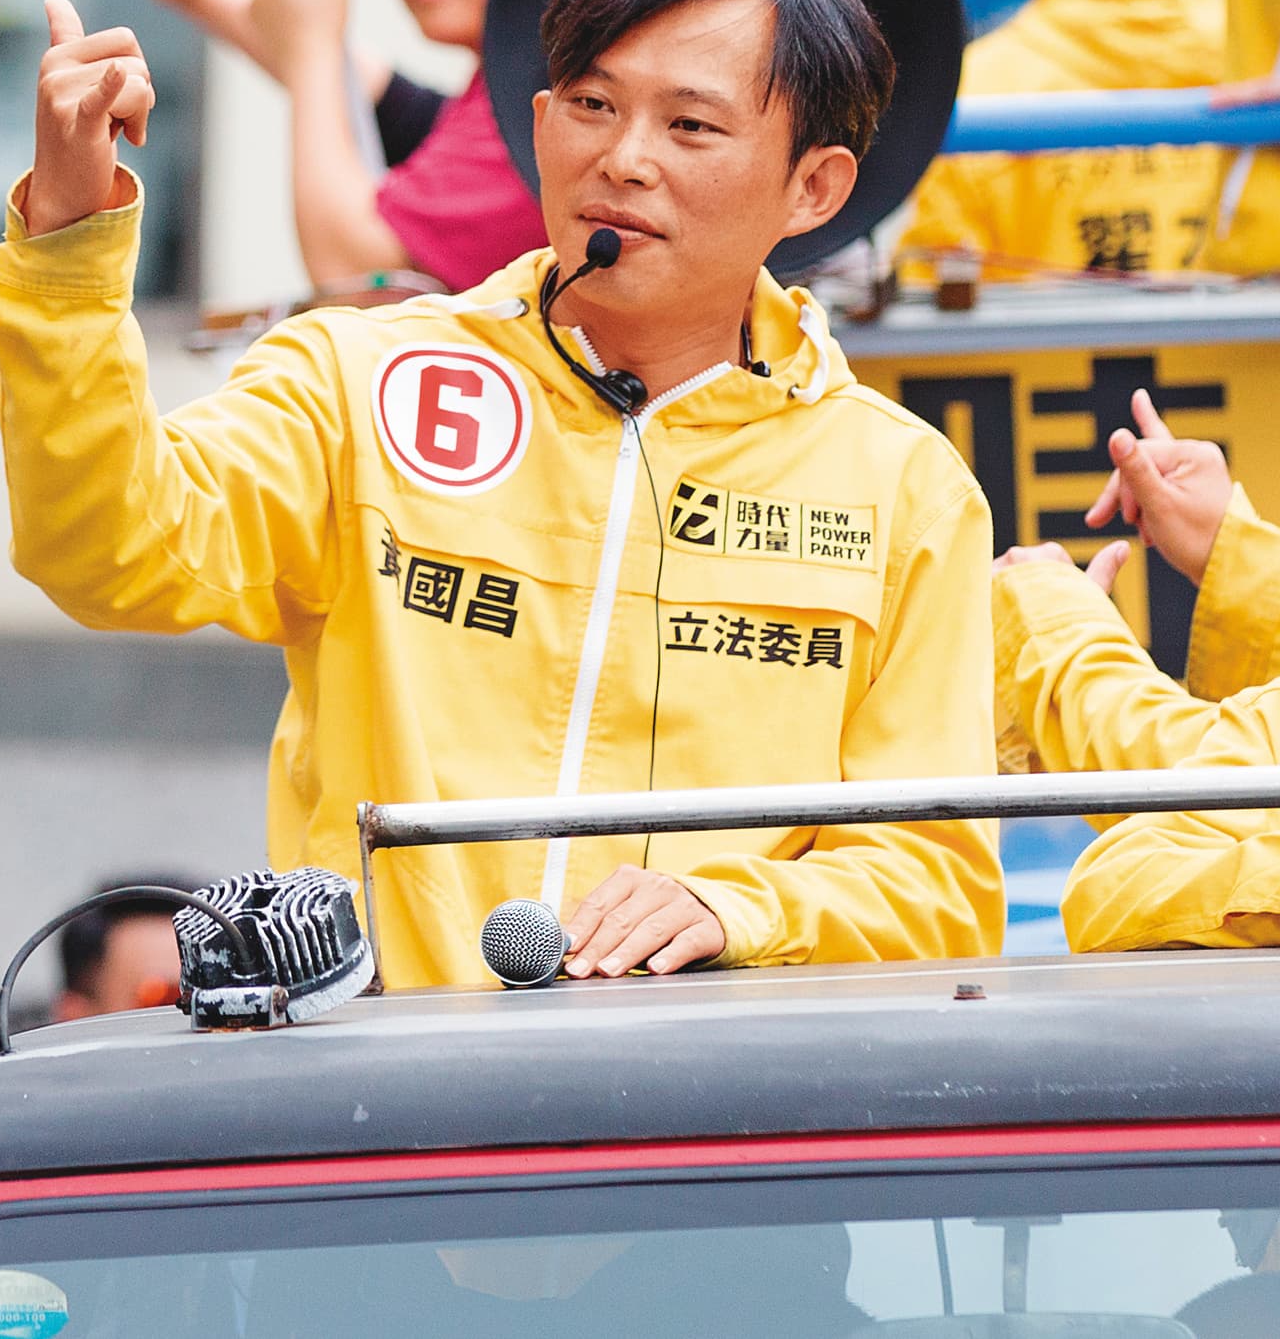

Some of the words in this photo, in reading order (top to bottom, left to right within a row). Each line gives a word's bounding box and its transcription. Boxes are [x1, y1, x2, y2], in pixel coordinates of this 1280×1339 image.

[414, 364, 484, 471] 6
[736, 500, 791, 529] 時代
[810, 509, 850, 526] NEW
[736, 528, 791, 553] 力量
[810, 526, 872, 545] POWER
[810, 542, 867, 561] PARTY
[665, 611, 844, 670] 立法委員
